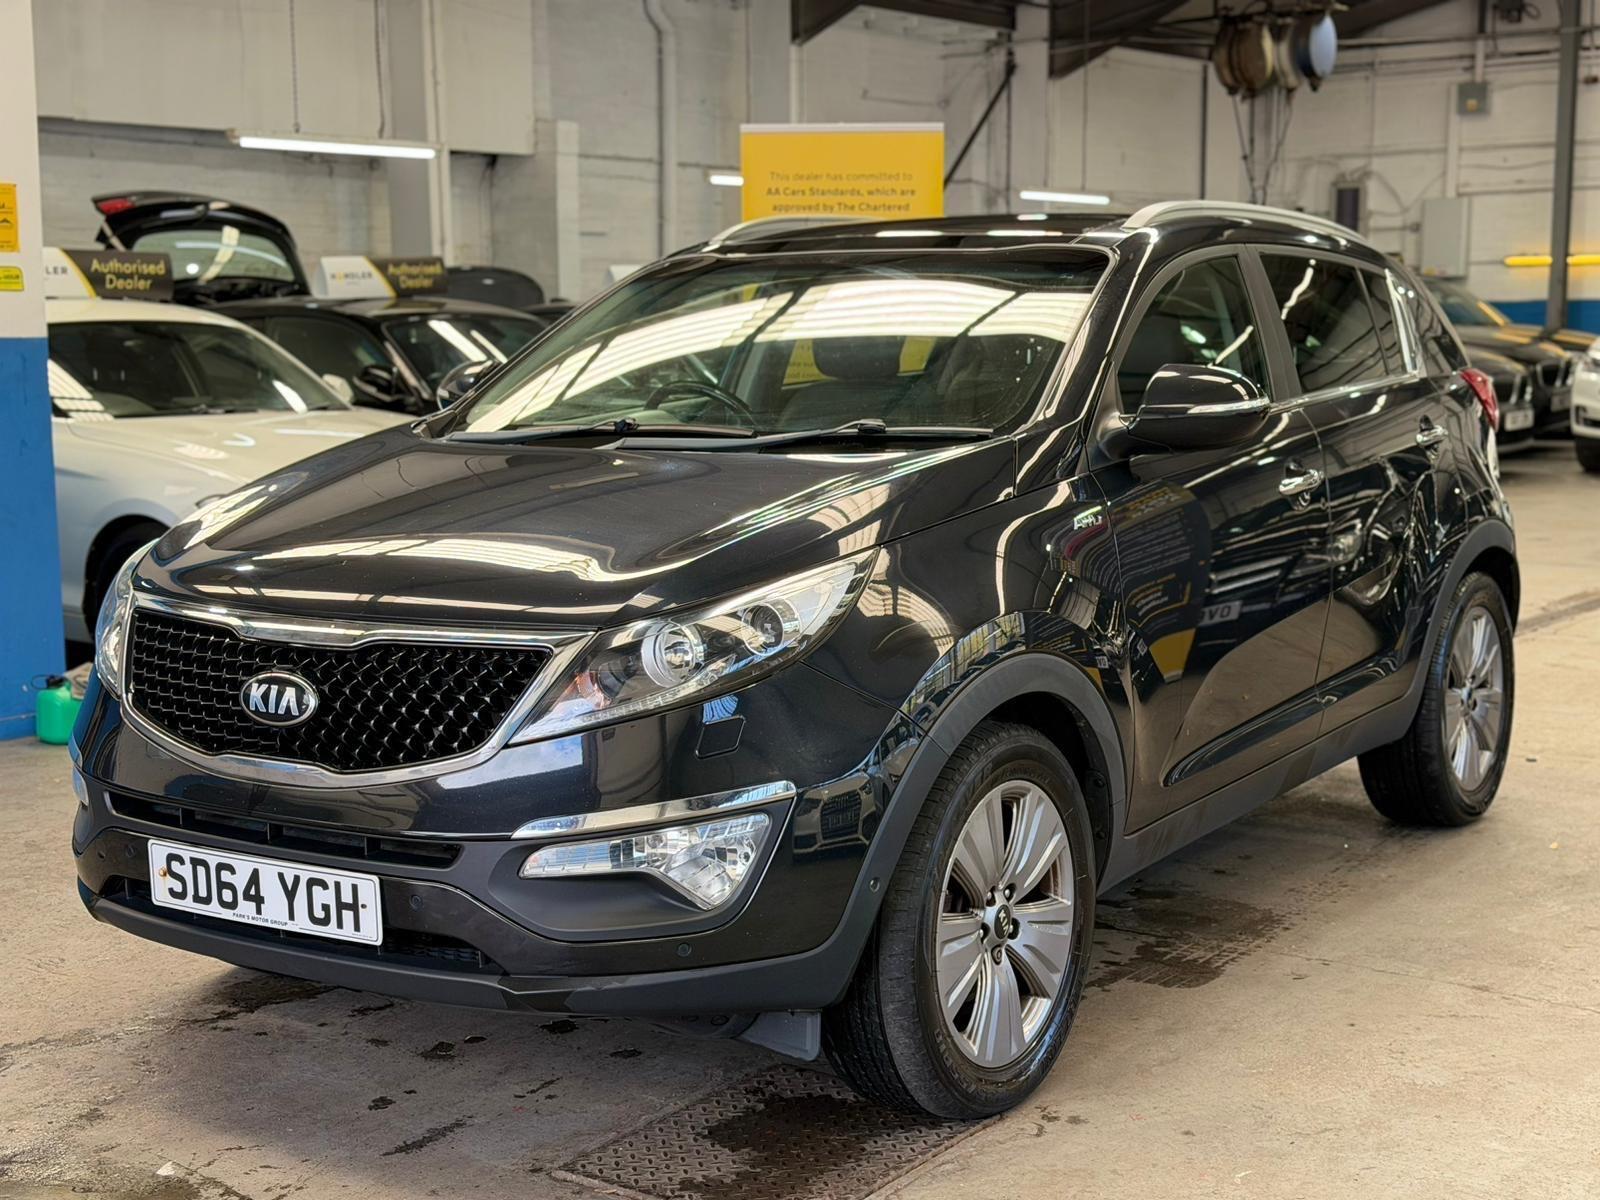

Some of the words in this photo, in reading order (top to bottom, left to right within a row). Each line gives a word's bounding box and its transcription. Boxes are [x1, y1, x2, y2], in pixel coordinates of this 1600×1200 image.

[770, 172, 790, 181] This
[792, 172, 823, 181] dealer
[826, 172, 842, 181] has
[846, 172, 900, 181] committed
[902, 172, 912, 181] to
[767, 187, 780, 196] AA
[783, 187, 805, 196] Cars
[809, 187, 864, 197] Standards,
[868, 187, 897, 196] which
[900, 188, 916, 196] are
[772, 203, 820, 213] approved
[823, 203, 834, 213] by
[837, 202, 856, 212] The
[858, 202, 910, 212] Chartered
[90, 259, 166, 275] Authorised
[105, 274, 152, 290] Dealer
[399, 275, 433, 289] Dealer
[249, 682, 300, 716] KIA
[165, 852, 265, 916] SD64
[277, 871, 362, 933] YGH
[232, 912, 250, 920] PARK'S
[270, 919, 288, 927] GROUP
[998, 908, 1009, 936] KIA
